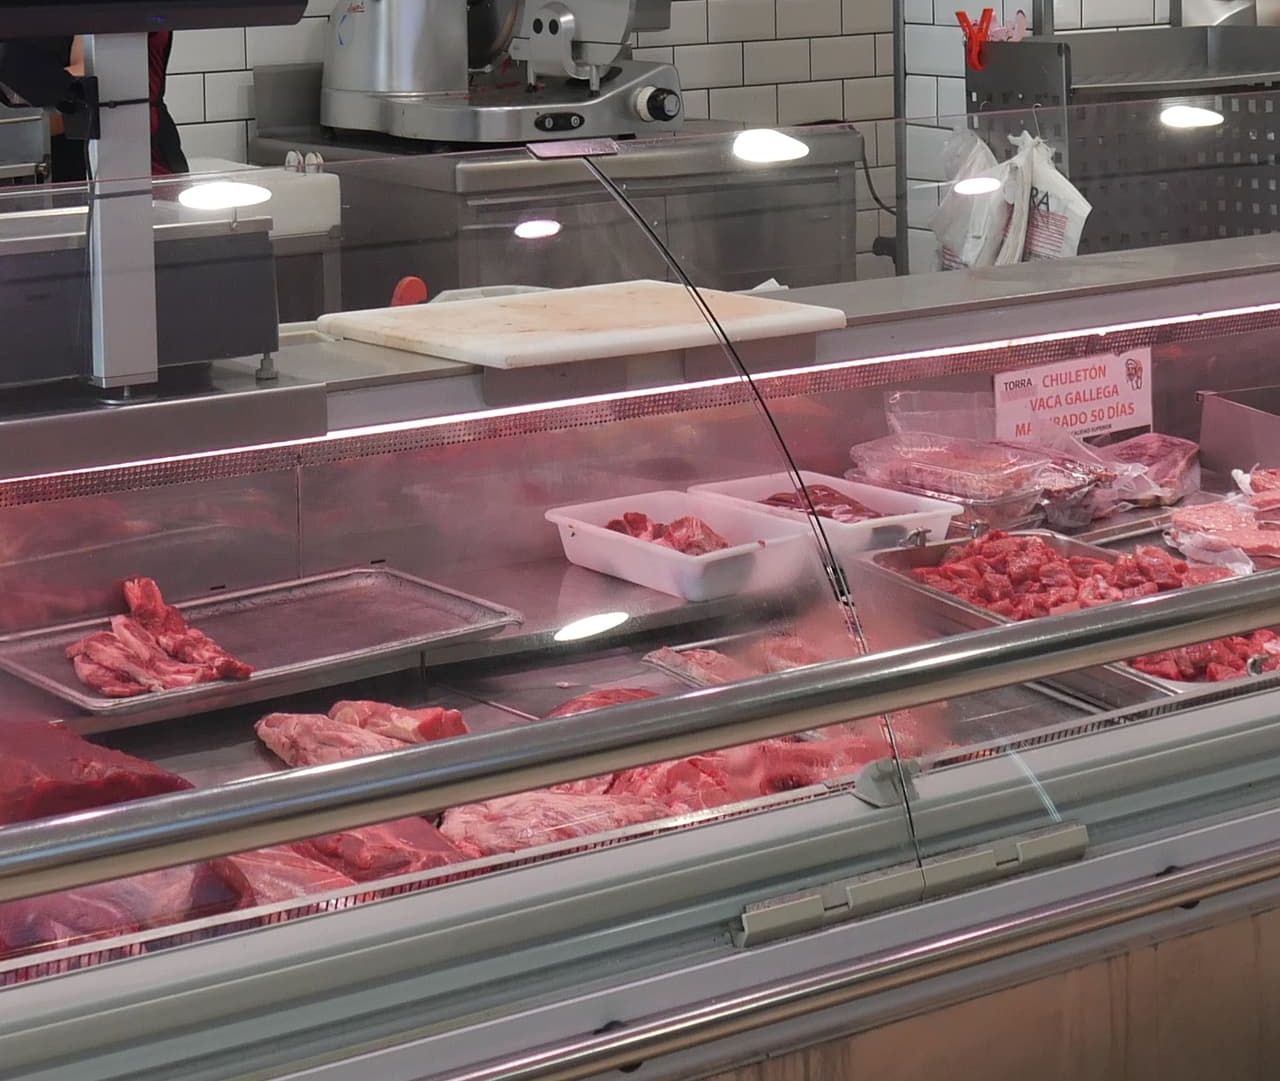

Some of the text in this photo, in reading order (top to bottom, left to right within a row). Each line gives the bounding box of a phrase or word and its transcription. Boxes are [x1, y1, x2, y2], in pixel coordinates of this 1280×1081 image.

[1004, 377, 1033, 392] TORRA
[1042, 365, 1107, 388] CHULETÓN
[1030, 384, 1120, 411] VACA GALLEGA
[1091, 406, 1105, 422] 50
[1108, 401, 1135, 418] DÍAS
